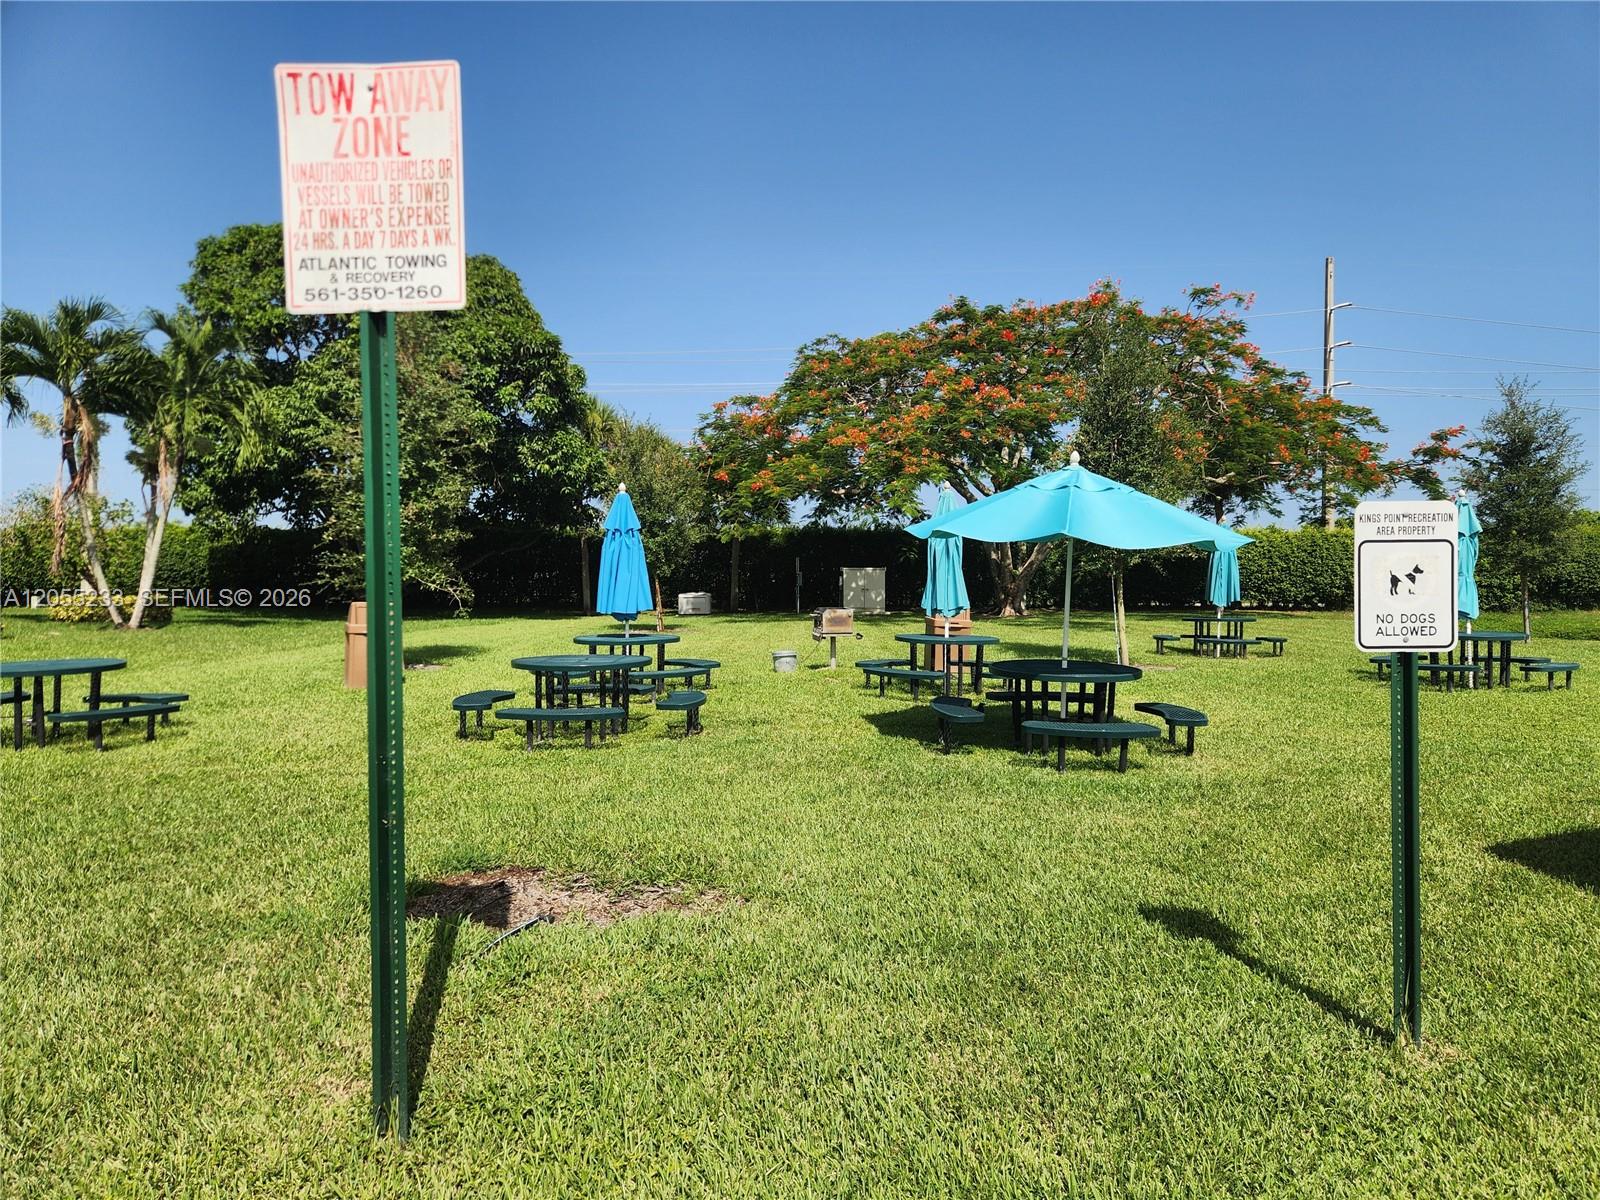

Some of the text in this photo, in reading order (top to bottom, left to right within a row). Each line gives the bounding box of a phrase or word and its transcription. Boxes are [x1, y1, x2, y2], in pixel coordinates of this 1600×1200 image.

[287, 69, 448, 115] TOW AWAY
[333, 115, 411, 159] ZONE
[291, 158, 453, 183] UNAUTHORIZED VEHICLES OR
[297, 182, 449, 206] VESSELS WILL BE TOWED
[298, 205, 449, 230] AT OWNER'S EXPENSE
[294, 227, 456, 251] 24 HRS. A DAY 7 DAYS A WK.
[298, 254, 447, 272] ATLANTIC TOWING
[329, 271, 416, 284] & RECOVERY
[304, 285, 442, 302] 561-350-1260
[1359, 512, 1454, 524] KINGS POINT RECREATION
[1376, 525, 1436, 536] AREA PROPERTY
[1376, 613, 1436, 624] NO DOGS
[1375, 626, 1437, 637] ALLOWED
